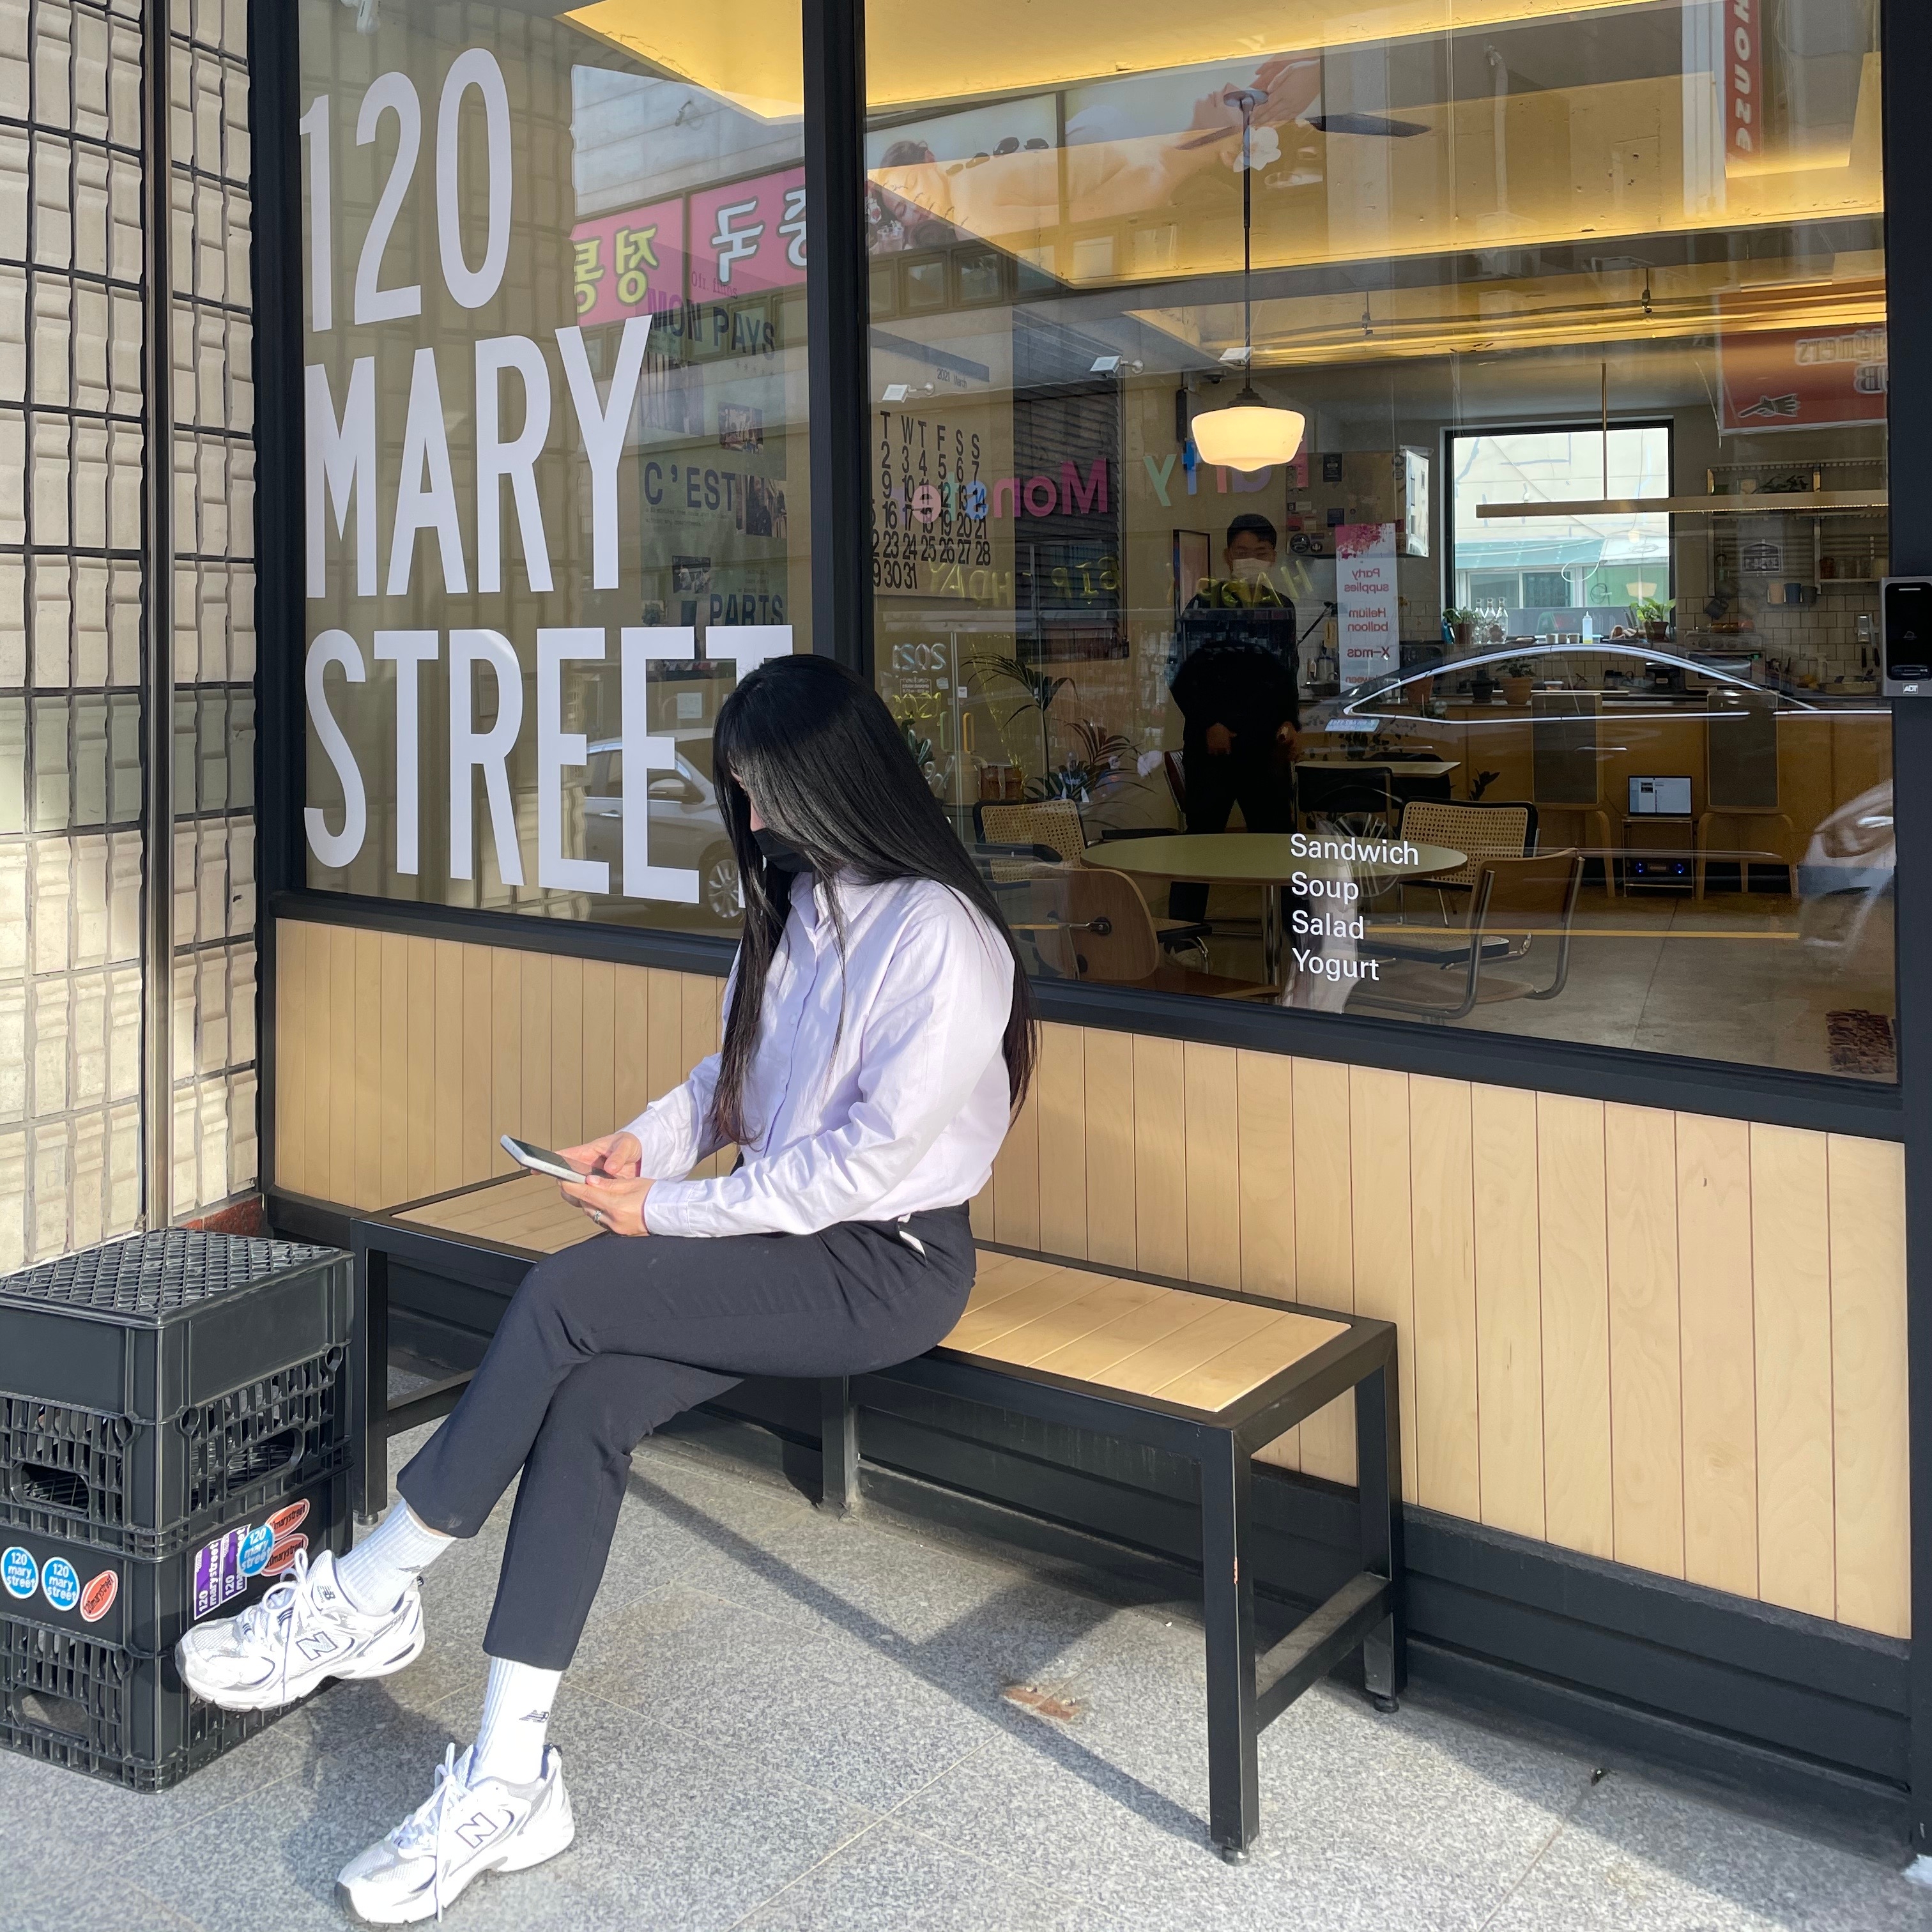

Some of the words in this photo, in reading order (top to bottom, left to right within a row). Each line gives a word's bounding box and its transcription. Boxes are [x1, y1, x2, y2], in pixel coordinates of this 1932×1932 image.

[299, 47, 512, 332] 120
[712, 306, 776, 361] PAYS
[880, 410, 891, 439] T
[901, 415, 914, 445] W
[918, 420, 926, 448] T
[937, 425, 946, 451] F
[956, 429, 963, 456] S
[971, 434, 979, 459] S
[305, 314, 652, 599] MARY
[882, 441, 891, 469] 2
[901, 445, 909, 473] 3
[919, 450, 927, 476] 4
[938, 454, 946, 480] 5
[956, 457, 963, 482] 6
[972, 461, 979, 485] 7
[644, 462, 735, 511] C'EST
[882, 471, 892, 499] 9
[902, 475, 915, 502] 10
[938, 482, 951, 509] 12
[958, 484, 967, 511] 13
[882, 501, 898, 530] 16
[902, 504, 914, 531] 17
[940, 509, 952, 536] 19
[956, 512, 972, 539] 20
[974, 515, 987, 540] 21
[883, 530, 900, 558] 23
[903, 532, 917, 560] 24
[921, 535, 936, 562] 25
[939, 537, 955, 564] 26
[958, 539, 971, 564] 27
[976, 540, 990, 566] 28
[884, 560, 902, 589] 30
[903, 561, 918, 589] 31
[1903, 685, 1919, 693] ADT
[1291, 833, 1418, 866] Sandwich
[1291, 871, 1359, 905] Soup
[1292, 910, 1364, 940] Salad
[1292, 947, 1379, 981] Yogurt
[244, 1539, 268, 1559] mary
[249, 1527, 266, 1545] 120
[8, 1565, 32, 1579] mary
[11, 1552, 27, 1566] 120
[52, 1563, 70, 1578] 120
[241, 1547, 270, 1570] street
[6, 1575, 36, 1589] street
[49, 1576, 73, 1590] mary
[208, 1542, 220, 1607] marystreet
[225, 1574, 234, 1597] 120
[47, 1586, 77, 1601] street
[199, 1590, 208, 1612] 120
[296, 1631, 338, 1661] N
[454, 1812, 498, 1849] N
